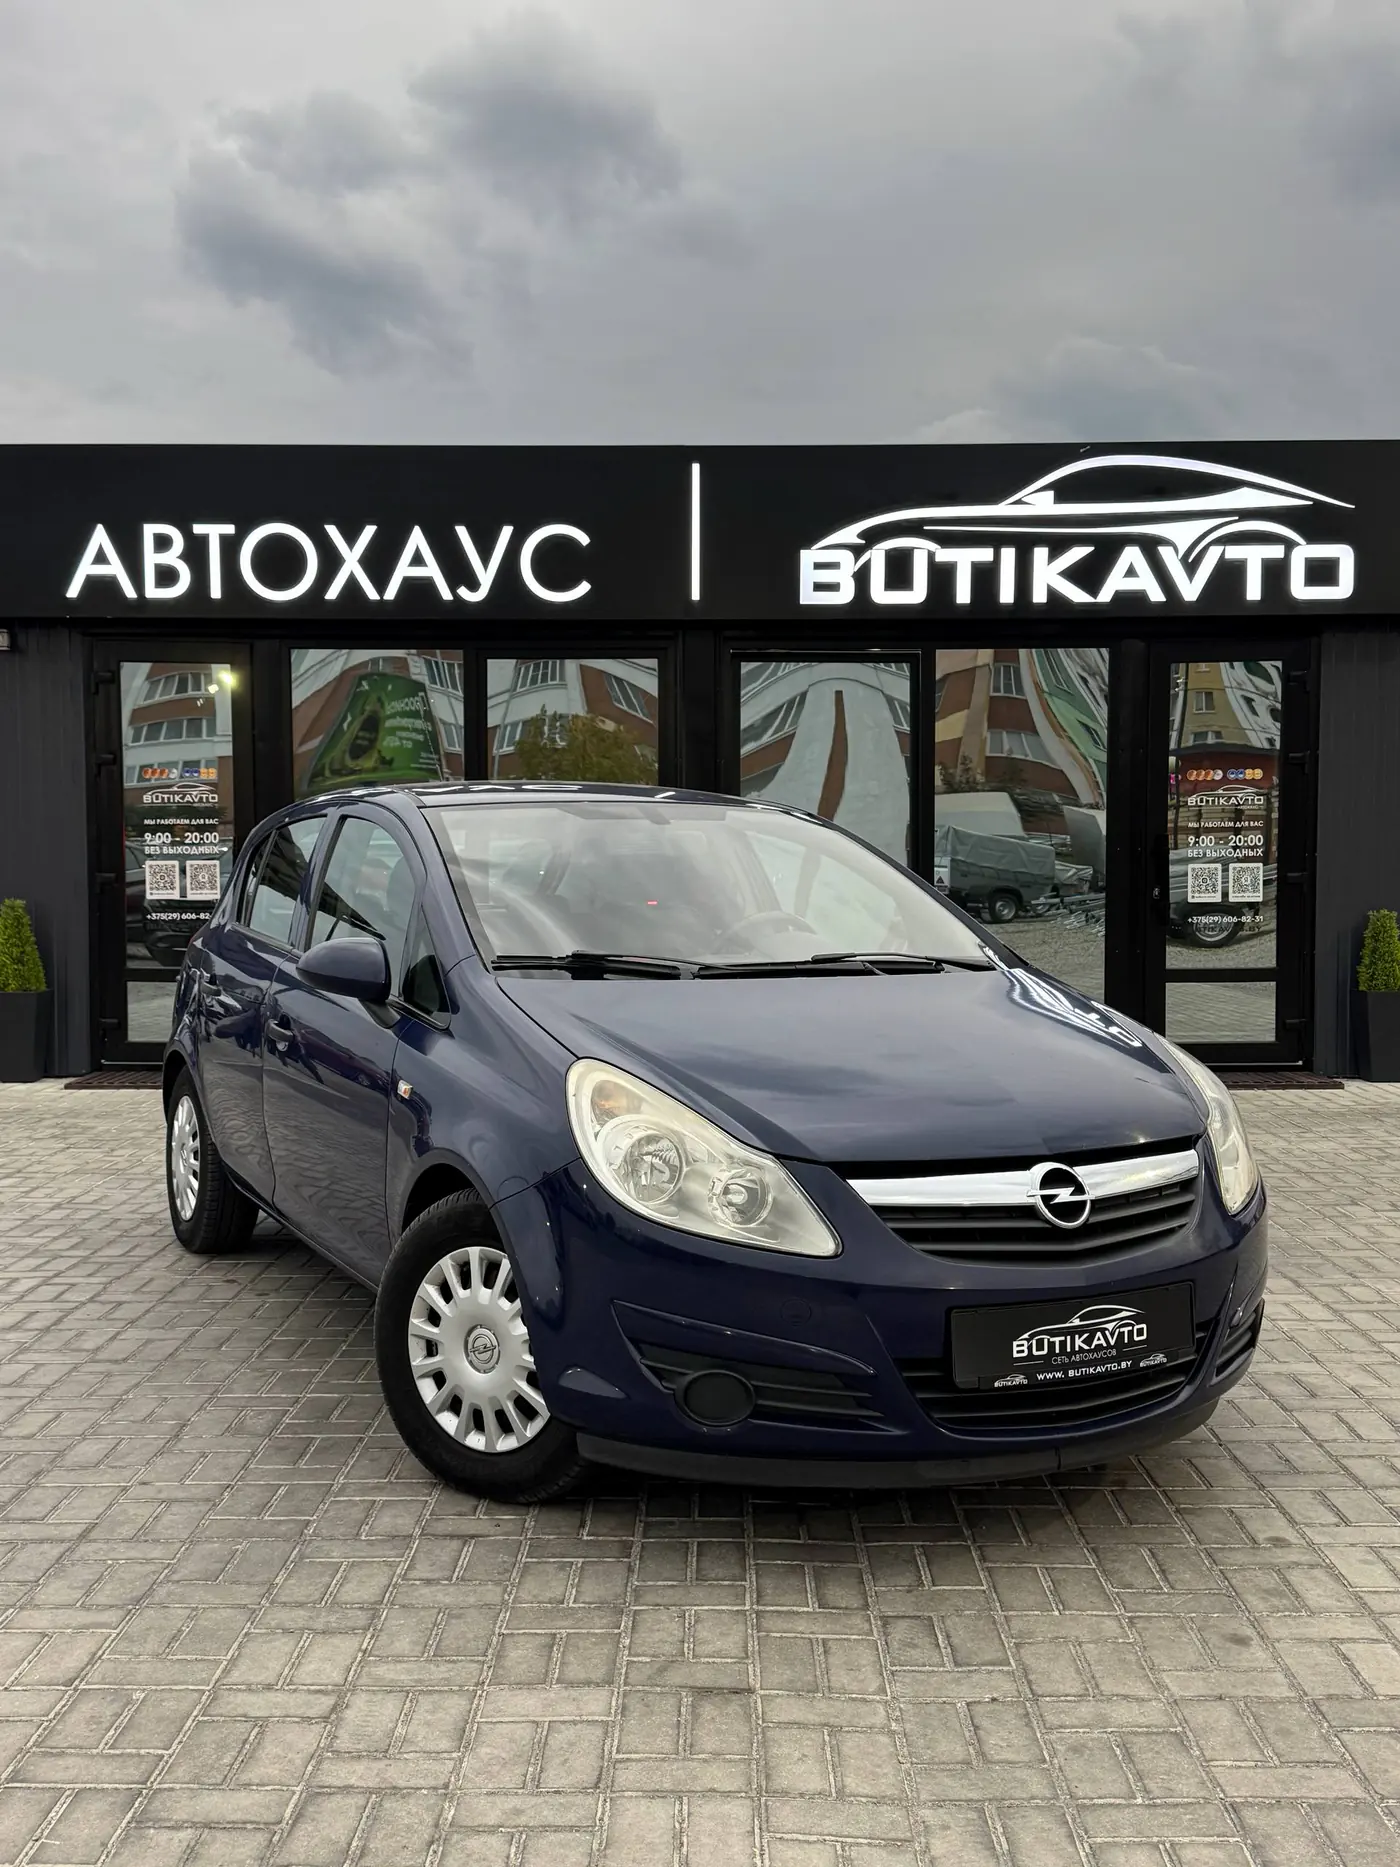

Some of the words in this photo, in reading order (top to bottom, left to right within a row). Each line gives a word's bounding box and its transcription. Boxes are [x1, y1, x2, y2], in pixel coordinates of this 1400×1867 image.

[65, 522, 592, 602] АВТОХАУС
[800, 543, 1355, 605] BUTIKAVTO
[143, 794, 218, 804] BUTIKAVTO
[1188, 796, 1264, 806] BUTIKAVTO
[144, 833, 172, 844] 9:00
[184, 832, 220, 844] 20:00
[1188, 835, 1215, 847] 9:00
[1228, 834, 1264, 846] 20:00
[144, 846, 161, 855] БЕЗ
[163, 845, 220, 855] ВЫХОДНЫХ
[1188, 849, 1204, 858] БЕЗ
[1206, 848, 1263, 857] ВЫХОДНЫХ
[146, 912, 180, 921] +375(29)
[1188, 915, 1222, 924] +375(29)
[1223, 915, 1264, 924] 606-82-31
[1012, 1323, 1148, 1358] BUTIKAVTO
[1051, 1356, 1070, 1365] СЕТЬ
[1070, 1349, 1117, 1363] АВТОХАУСОВ
[1139, 1357, 1168, 1368] BUTIKAVTO
[1036, 1371, 1065, 1381] WWW.
[1068, 1360, 1133, 1378] BUTIKAVTO.BY
[994, 1379, 1028, 1388] BUTIKAVTO
